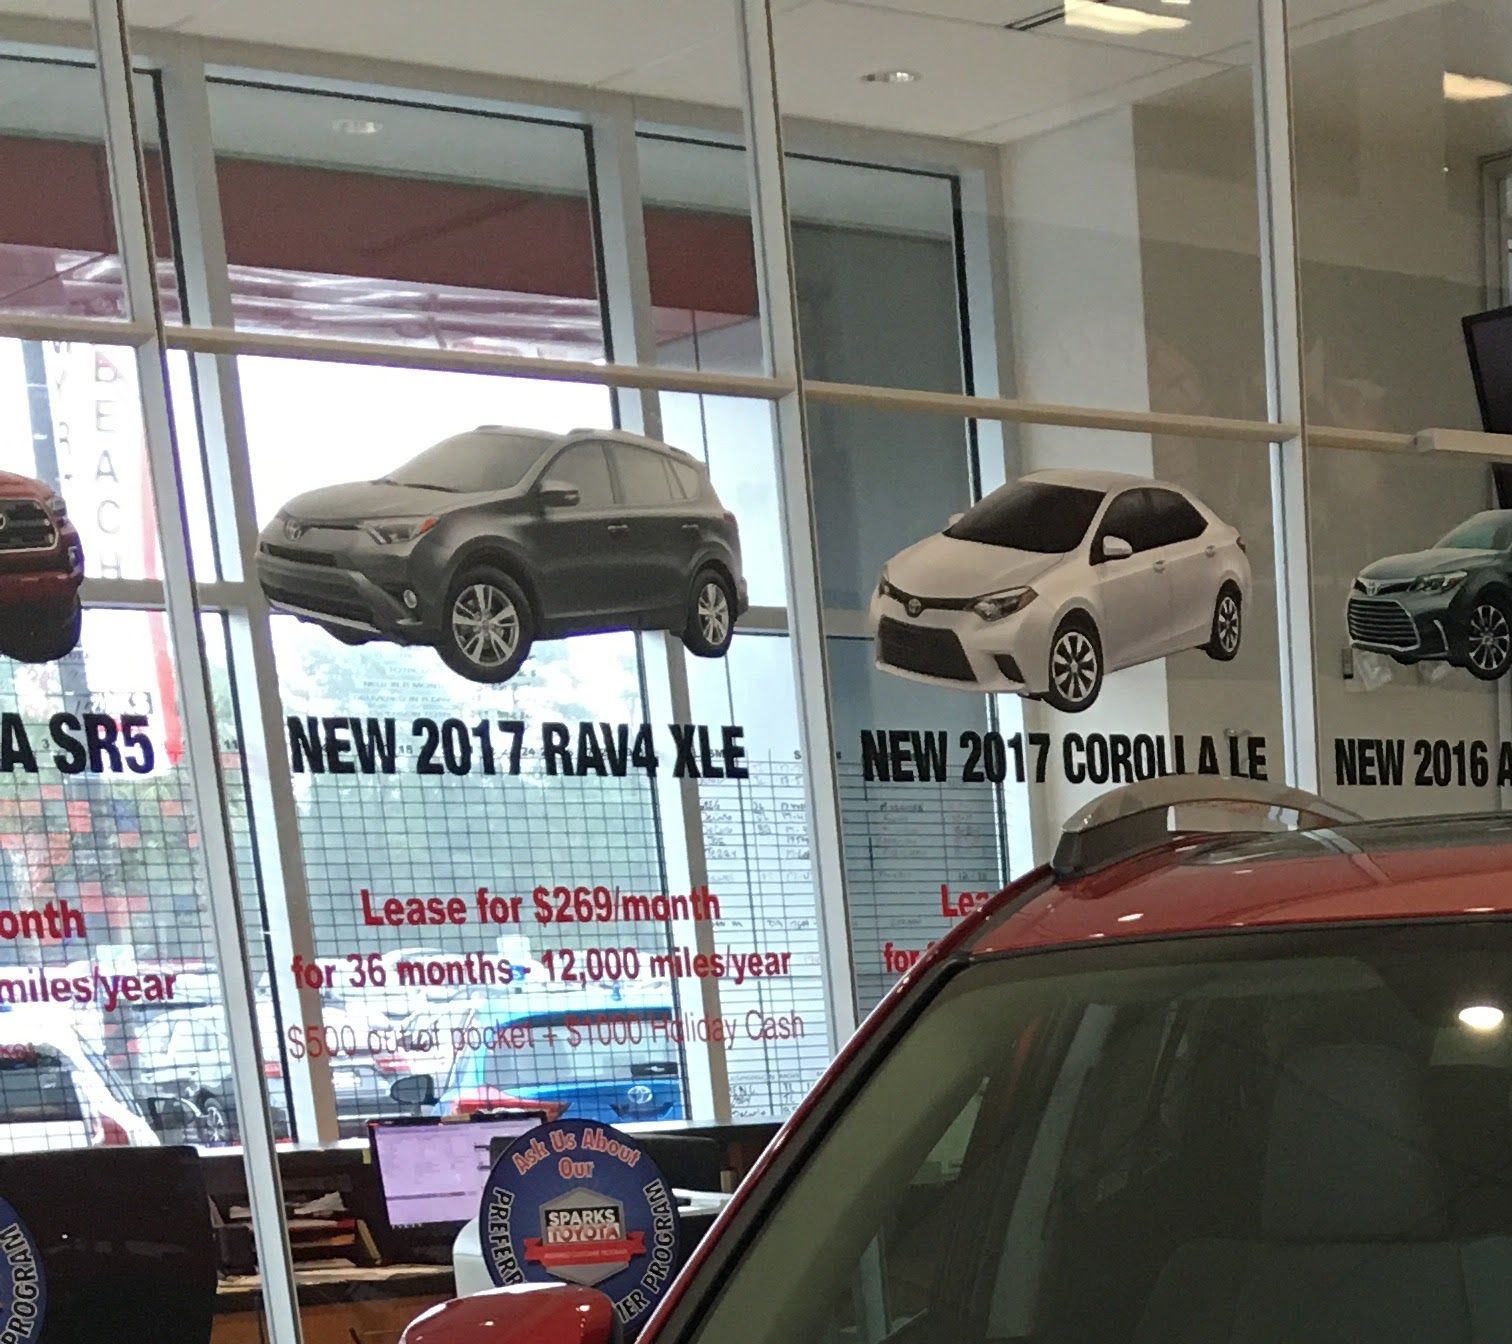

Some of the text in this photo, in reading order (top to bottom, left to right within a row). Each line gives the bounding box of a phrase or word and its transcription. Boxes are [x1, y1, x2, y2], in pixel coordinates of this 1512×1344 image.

[50, 712, 154, 774] SR5
[287, 716, 749, 779] NEW 2017 RAV4 XLE
[860, 729, 948, 783] NEW
[960, 731, 1051, 783] 2017
[1229, 736, 1268, 781] LE
[1334, 738, 1404, 786] NEW
[1413, 740, 1489, 787] 2016
[360, 885, 721, 928] Lease for $269/month
[291, 954, 337, 990] for
[347, 953, 387, 988] 36
[396, 951, 514, 986] months
[541, 948, 640, 991] 12,000
[650, 944, 792, 985] miles/year
[288, 1024, 356, 1060] $500
[450, 1018, 535, 1063] pocket
[565, 1012, 644, 1048] $1000
[651, 1011, 737, 1050] Holiday
[745, 1009, 805, 1042] Cash
[512, 1138, 550, 1175] Ask
[550, 1129, 577, 1152] Us
[581, 1128, 641, 1167] About
[558, 1156, 595, 1179] Our
[488, 1187, 526, 1286] PREFERR
[548, 1209, 616, 1226] SPARKS
[548, 1223, 619, 1242] TOYOTA
[641, 1178, 675, 1293] PROGRAM
